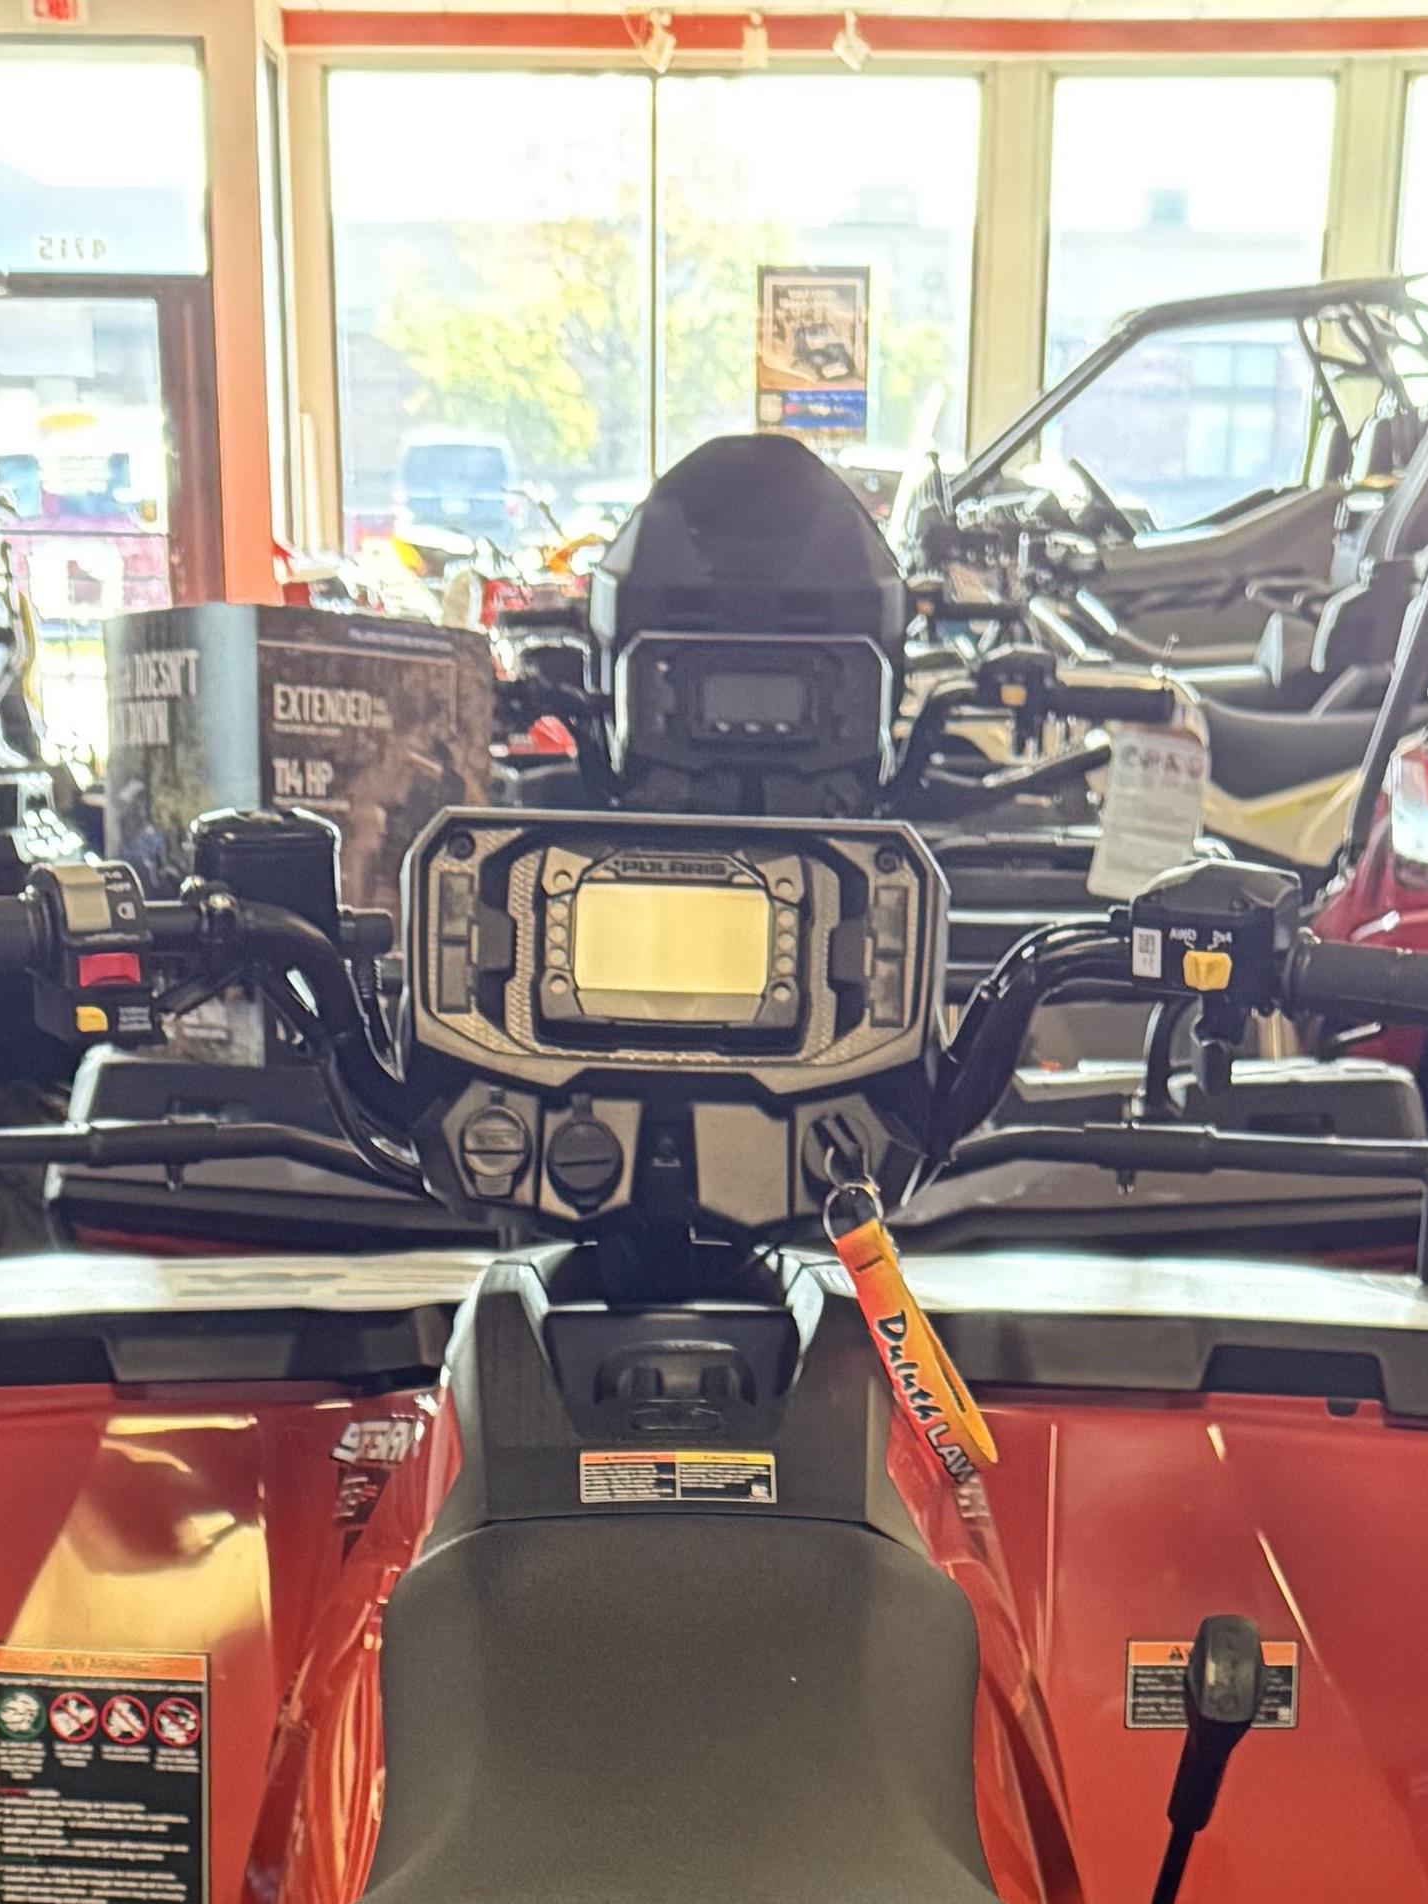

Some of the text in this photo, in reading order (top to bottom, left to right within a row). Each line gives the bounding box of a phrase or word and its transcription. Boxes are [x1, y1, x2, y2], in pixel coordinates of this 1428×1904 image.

[273, 683, 371, 729] EXTENDED
[305, 758, 333, 796] HP
[622, 860, 726, 875] POLARIS
[875, 1309, 944, 1424] Duluth
